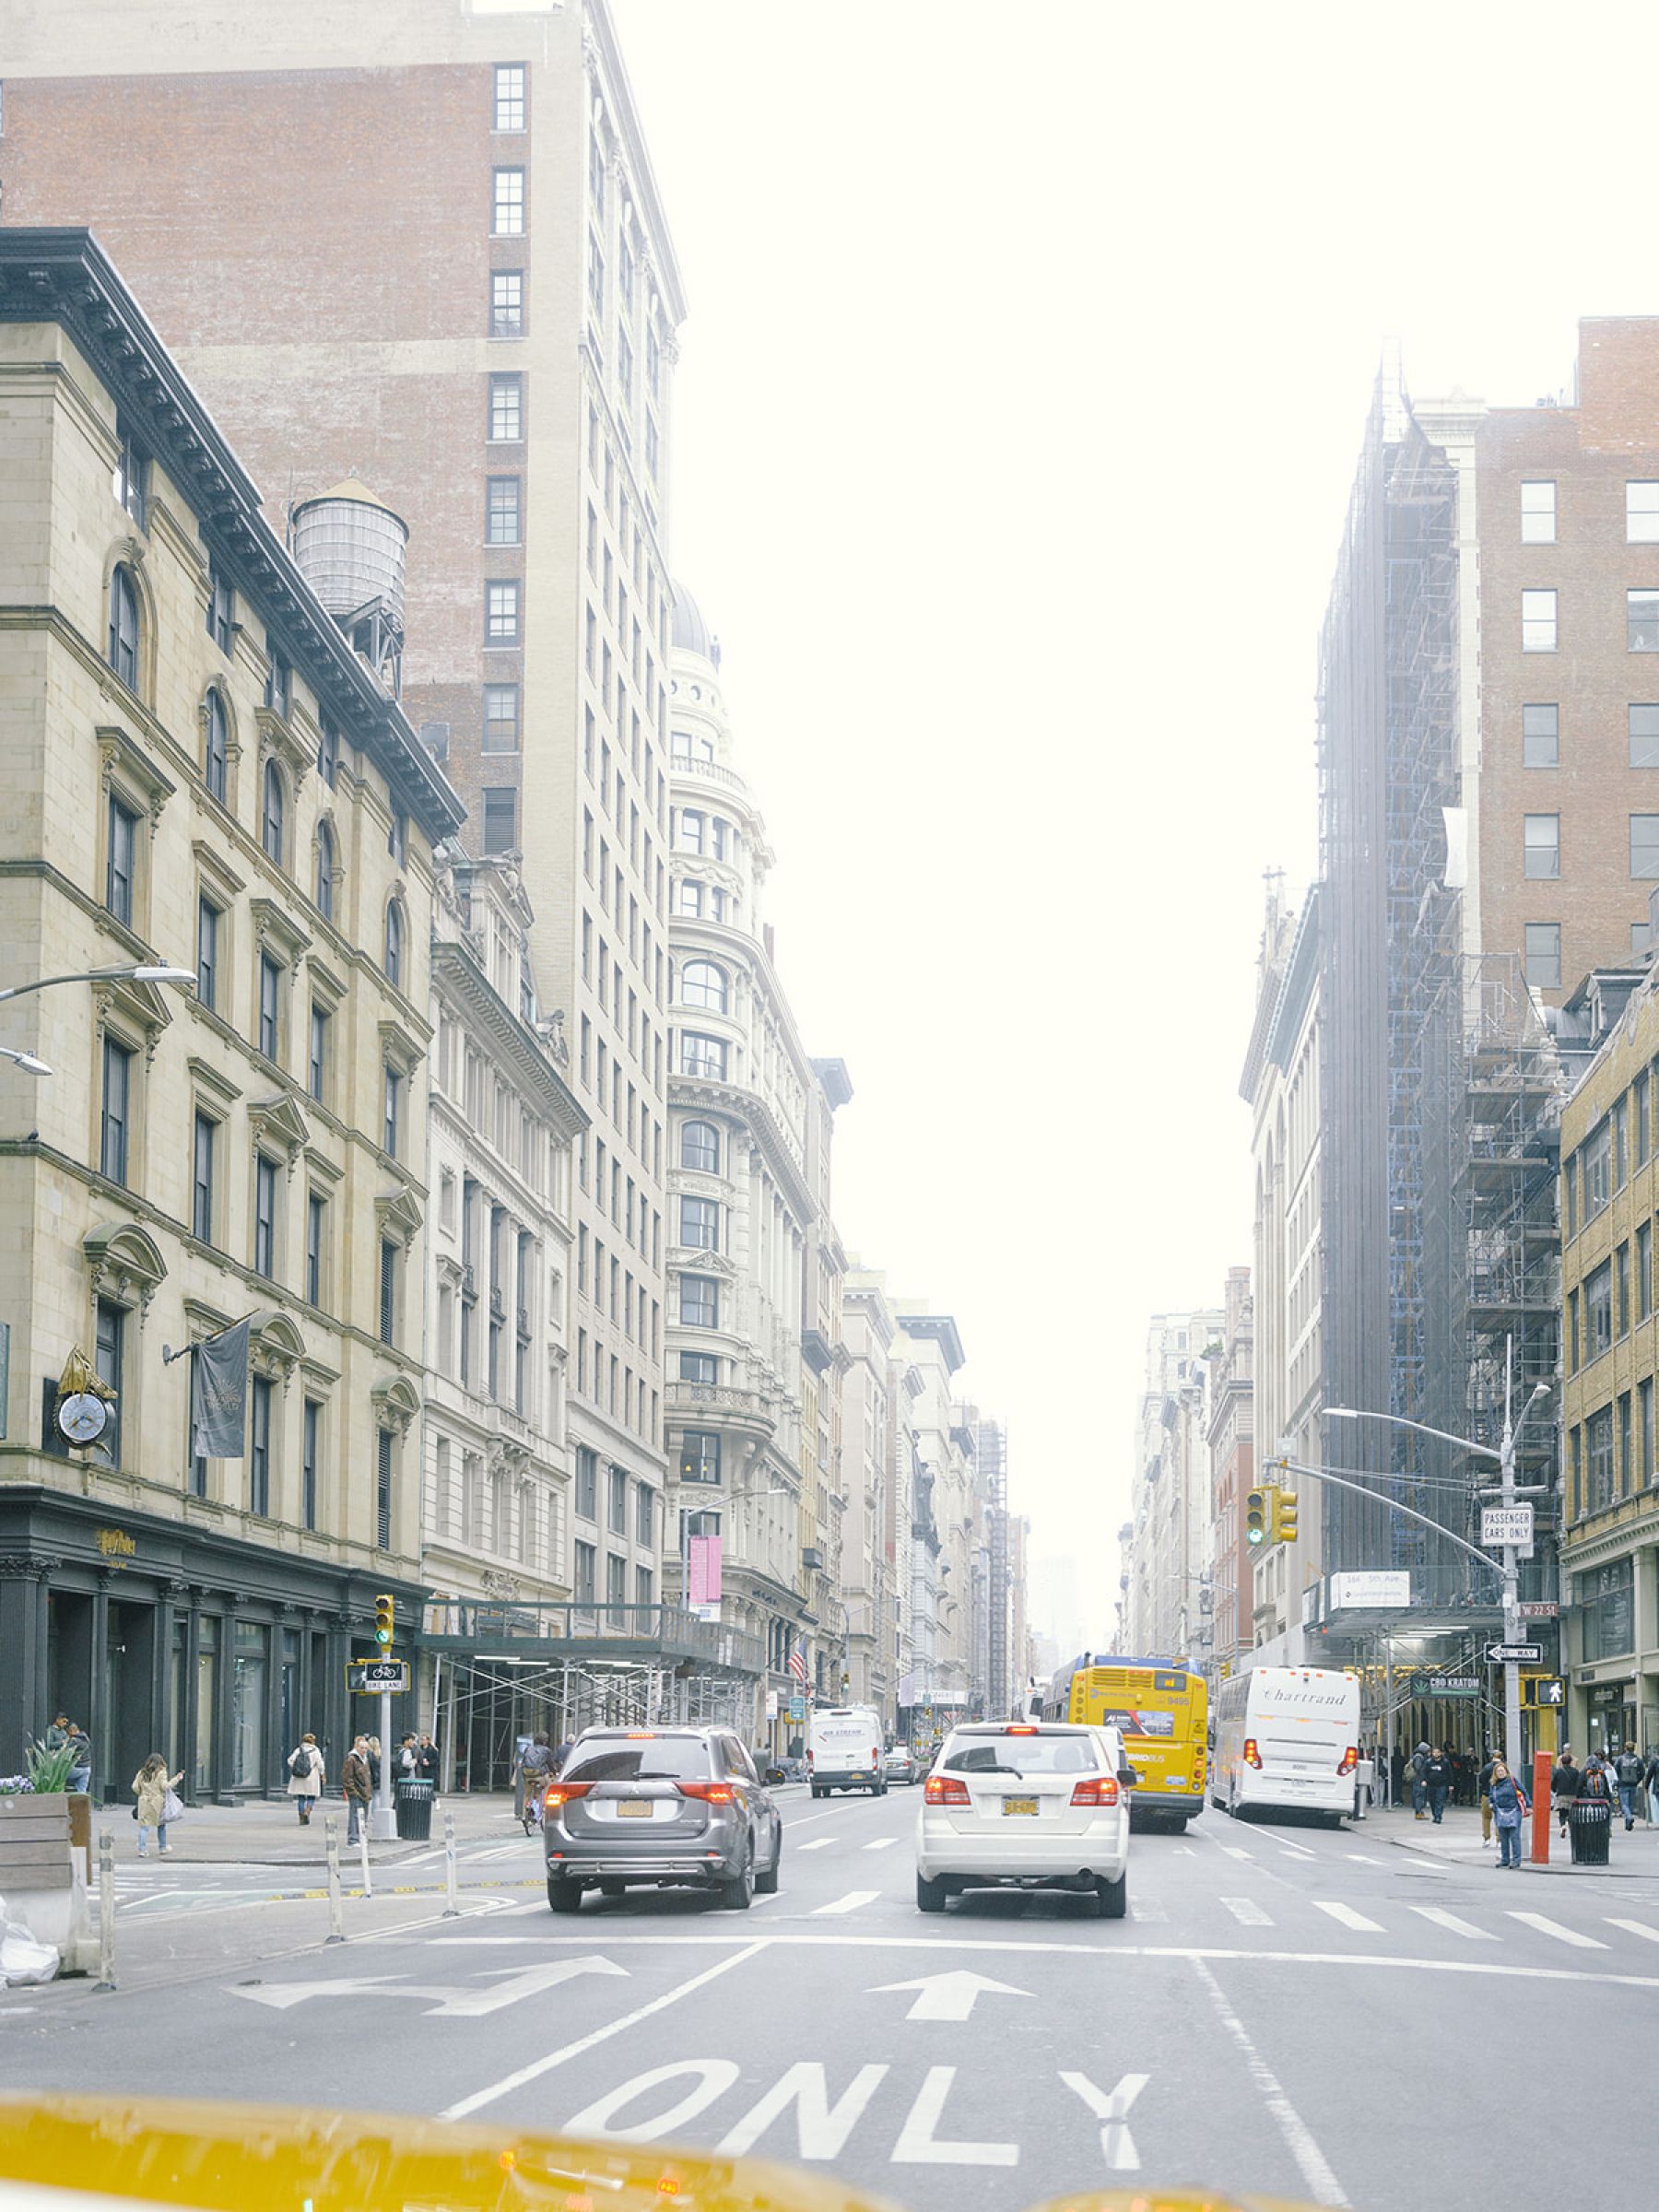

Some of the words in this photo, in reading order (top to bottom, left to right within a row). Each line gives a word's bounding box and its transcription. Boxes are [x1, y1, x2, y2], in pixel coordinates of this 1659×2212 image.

[1485, 1512, 1530, 1524] PASSENGER
[1485, 1527, 1504, 1537] CARS
[1510, 1527, 1529, 1537] ONLY
[1522, 1606, 1531, 1615] W
[1535, 1606, 1544, 1615] 22
[1494, 1648, 1509, 1656] ONE
[1448, 1677, 1479, 1688] KRATOM
[1263, 1688, 1347, 1705] Chartrand
[561, 2059, 1151, 2170] ONLY
